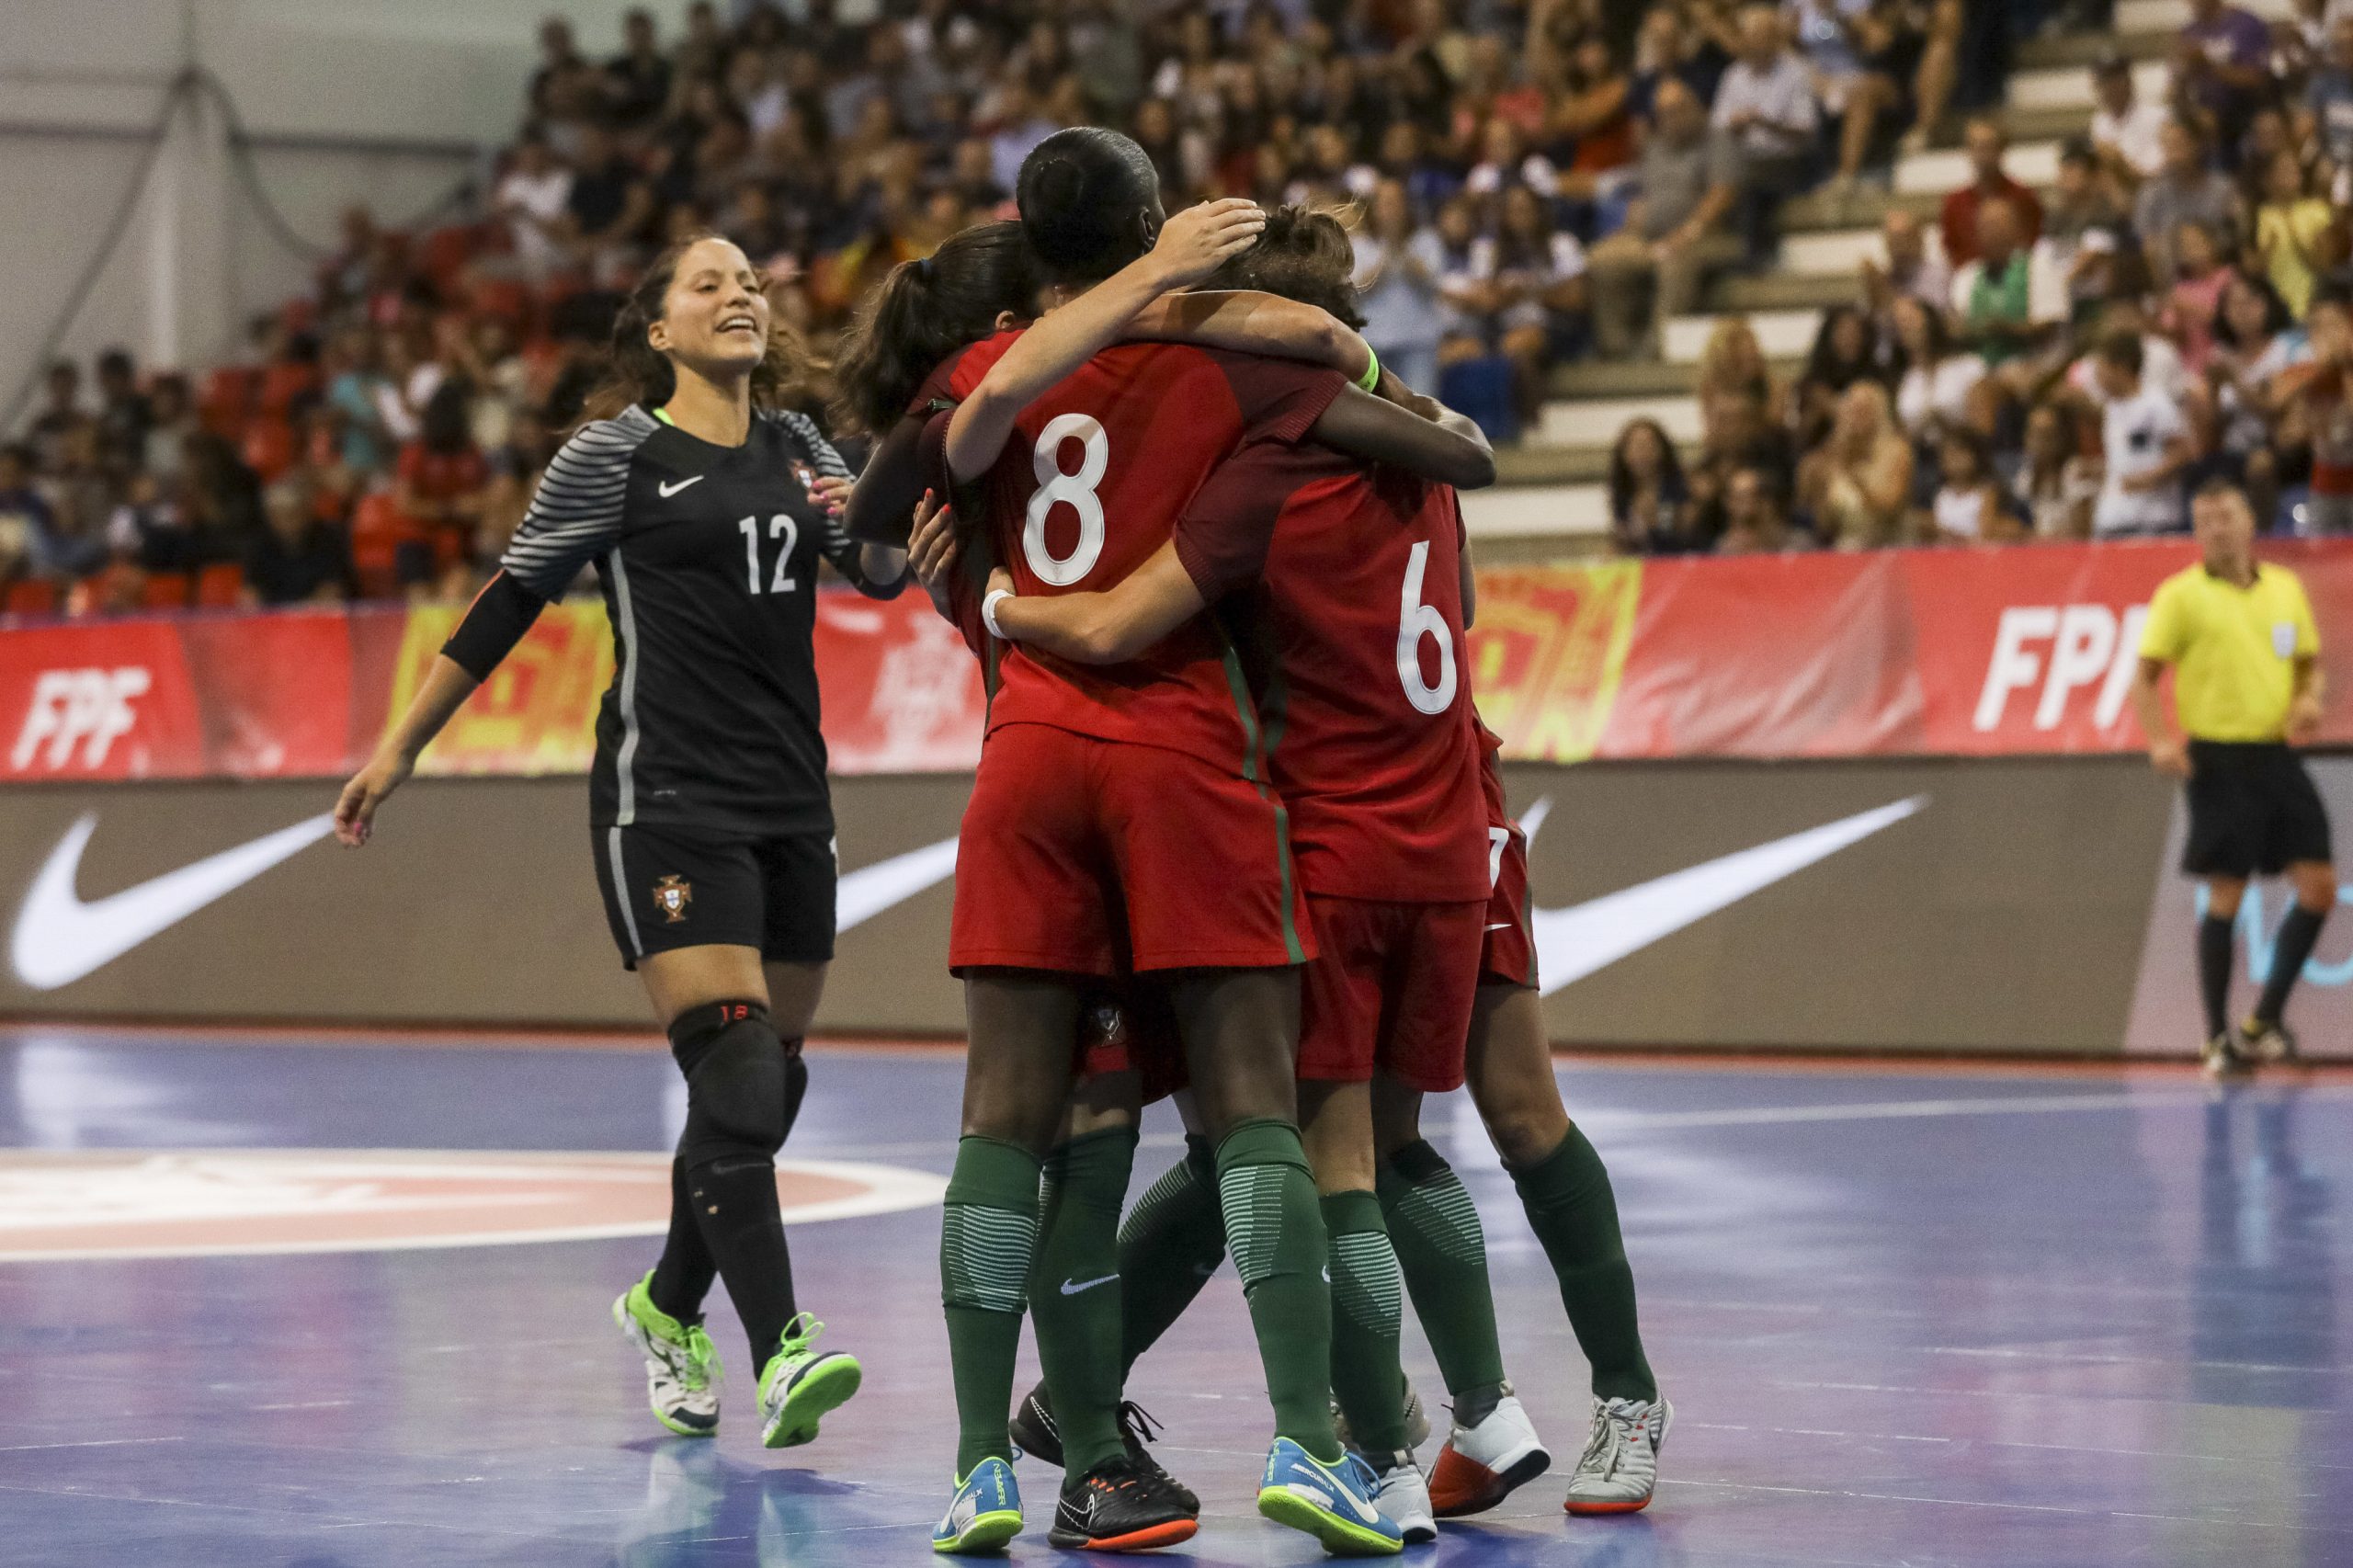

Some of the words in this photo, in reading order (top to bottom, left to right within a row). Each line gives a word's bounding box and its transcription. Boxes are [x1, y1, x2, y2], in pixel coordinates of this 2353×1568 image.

[1023, 413, 1108, 586] 8
[738, 514, 798, 595] 12
[1396, 540, 1457, 715] 6
[10, 665, 153, 771] FPF
[1488, 826, 1509, 890] 7
